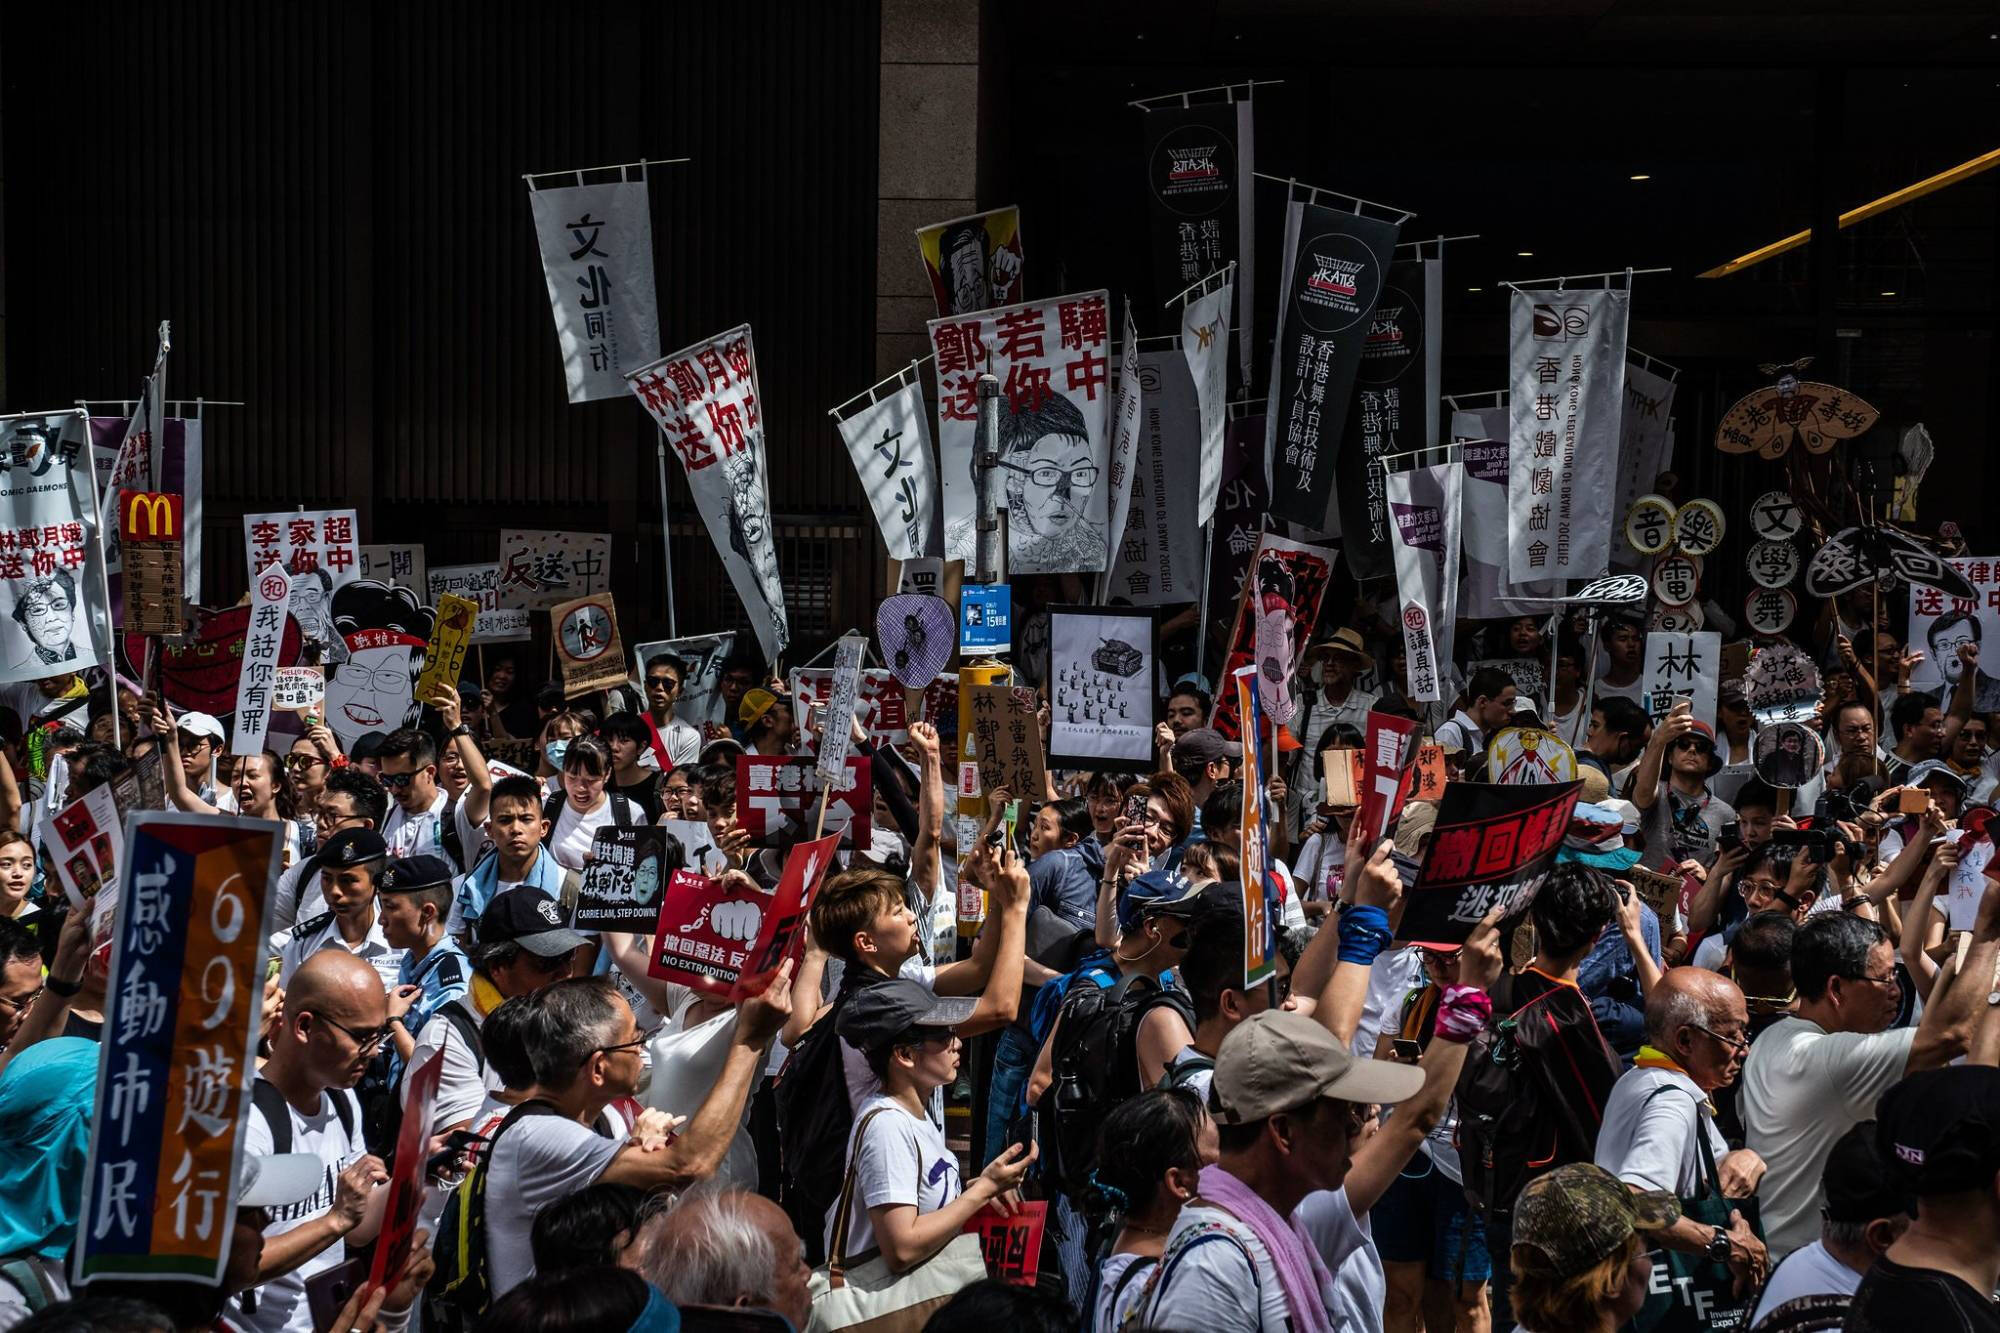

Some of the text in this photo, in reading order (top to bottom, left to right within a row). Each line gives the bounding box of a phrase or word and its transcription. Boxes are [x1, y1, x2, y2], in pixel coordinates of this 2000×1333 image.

[934, 296, 1107, 375] 鄭若驊
[941, 350, 1107, 422] 送你中
[1285, 334, 1317, 466] 設計人員協會
[1296, 340, 1335, 493] 香港舞台技術及
[1, 487, 27, 498] OMIC
[251, 517, 352, 550] 李家超
[1634, 506, 1714, 551] 音樂
[0, 545, 86, 580] 送你中
[254, 546, 353, 577] 送你中
[500, 547, 602, 597] 反送中
[242, 604, 280, 736] 我話你有罪
[1408, 630, 1435, 695] 講真話
[577, 909, 600, 920] CARRIE
[617, 908, 633, 918] STEP
[662, 954, 678, 967] NO
[664, 933, 726, 964] 撤回惡法
[93, 852, 177, 1241] 感動市民
[171, 873, 244, 1243] 69遊行
[1711, 1316, 1734, 1330] Expo
